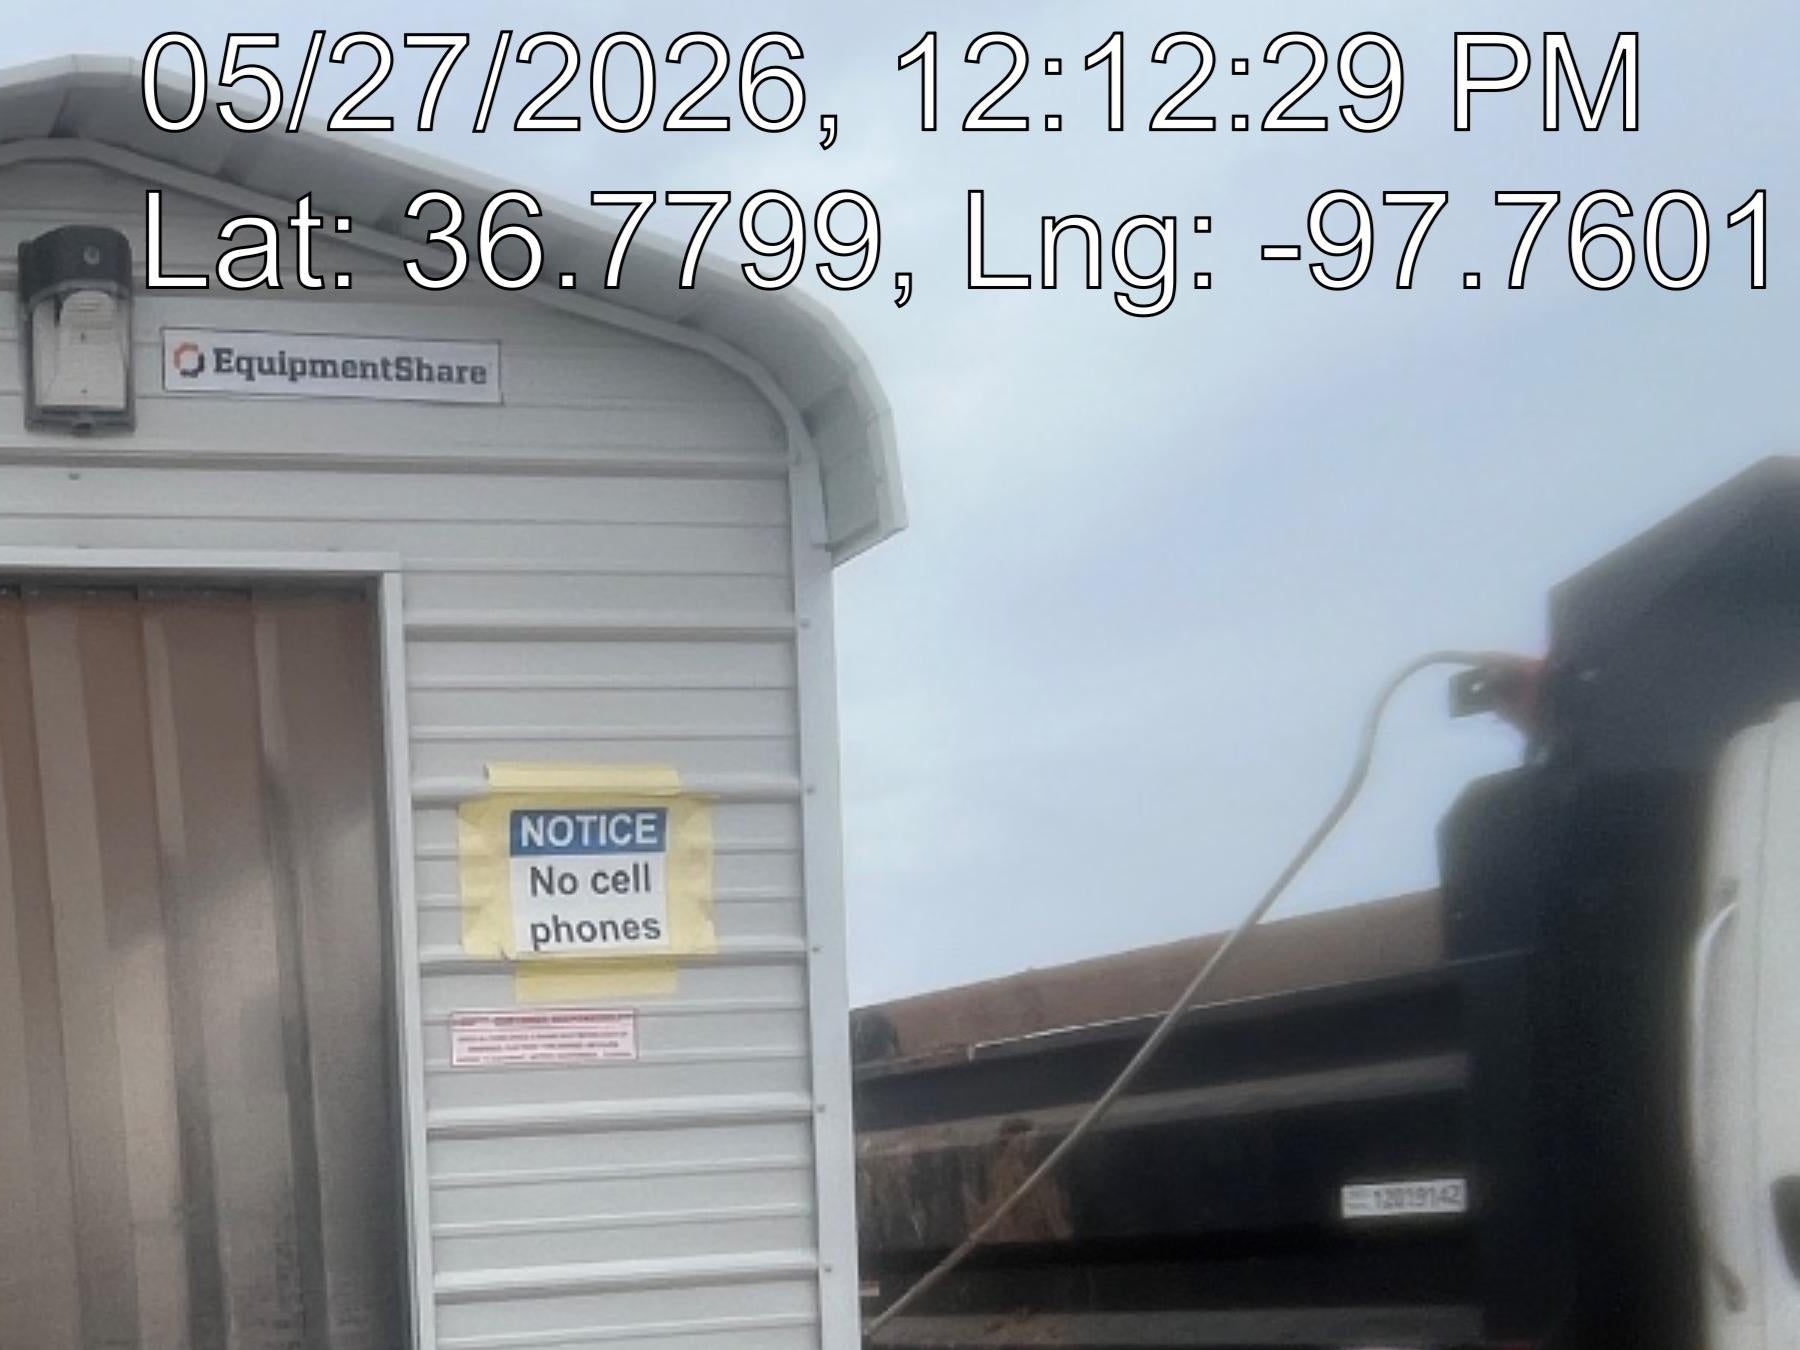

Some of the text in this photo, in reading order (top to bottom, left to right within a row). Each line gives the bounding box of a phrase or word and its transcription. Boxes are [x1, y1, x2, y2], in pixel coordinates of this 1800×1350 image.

[212, 347, 488, 385] EquipmentShare
[519, 812, 659, 849] NOTICE
[530, 862, 652, 897] No cell
[529, 914, 662, 951] phones
